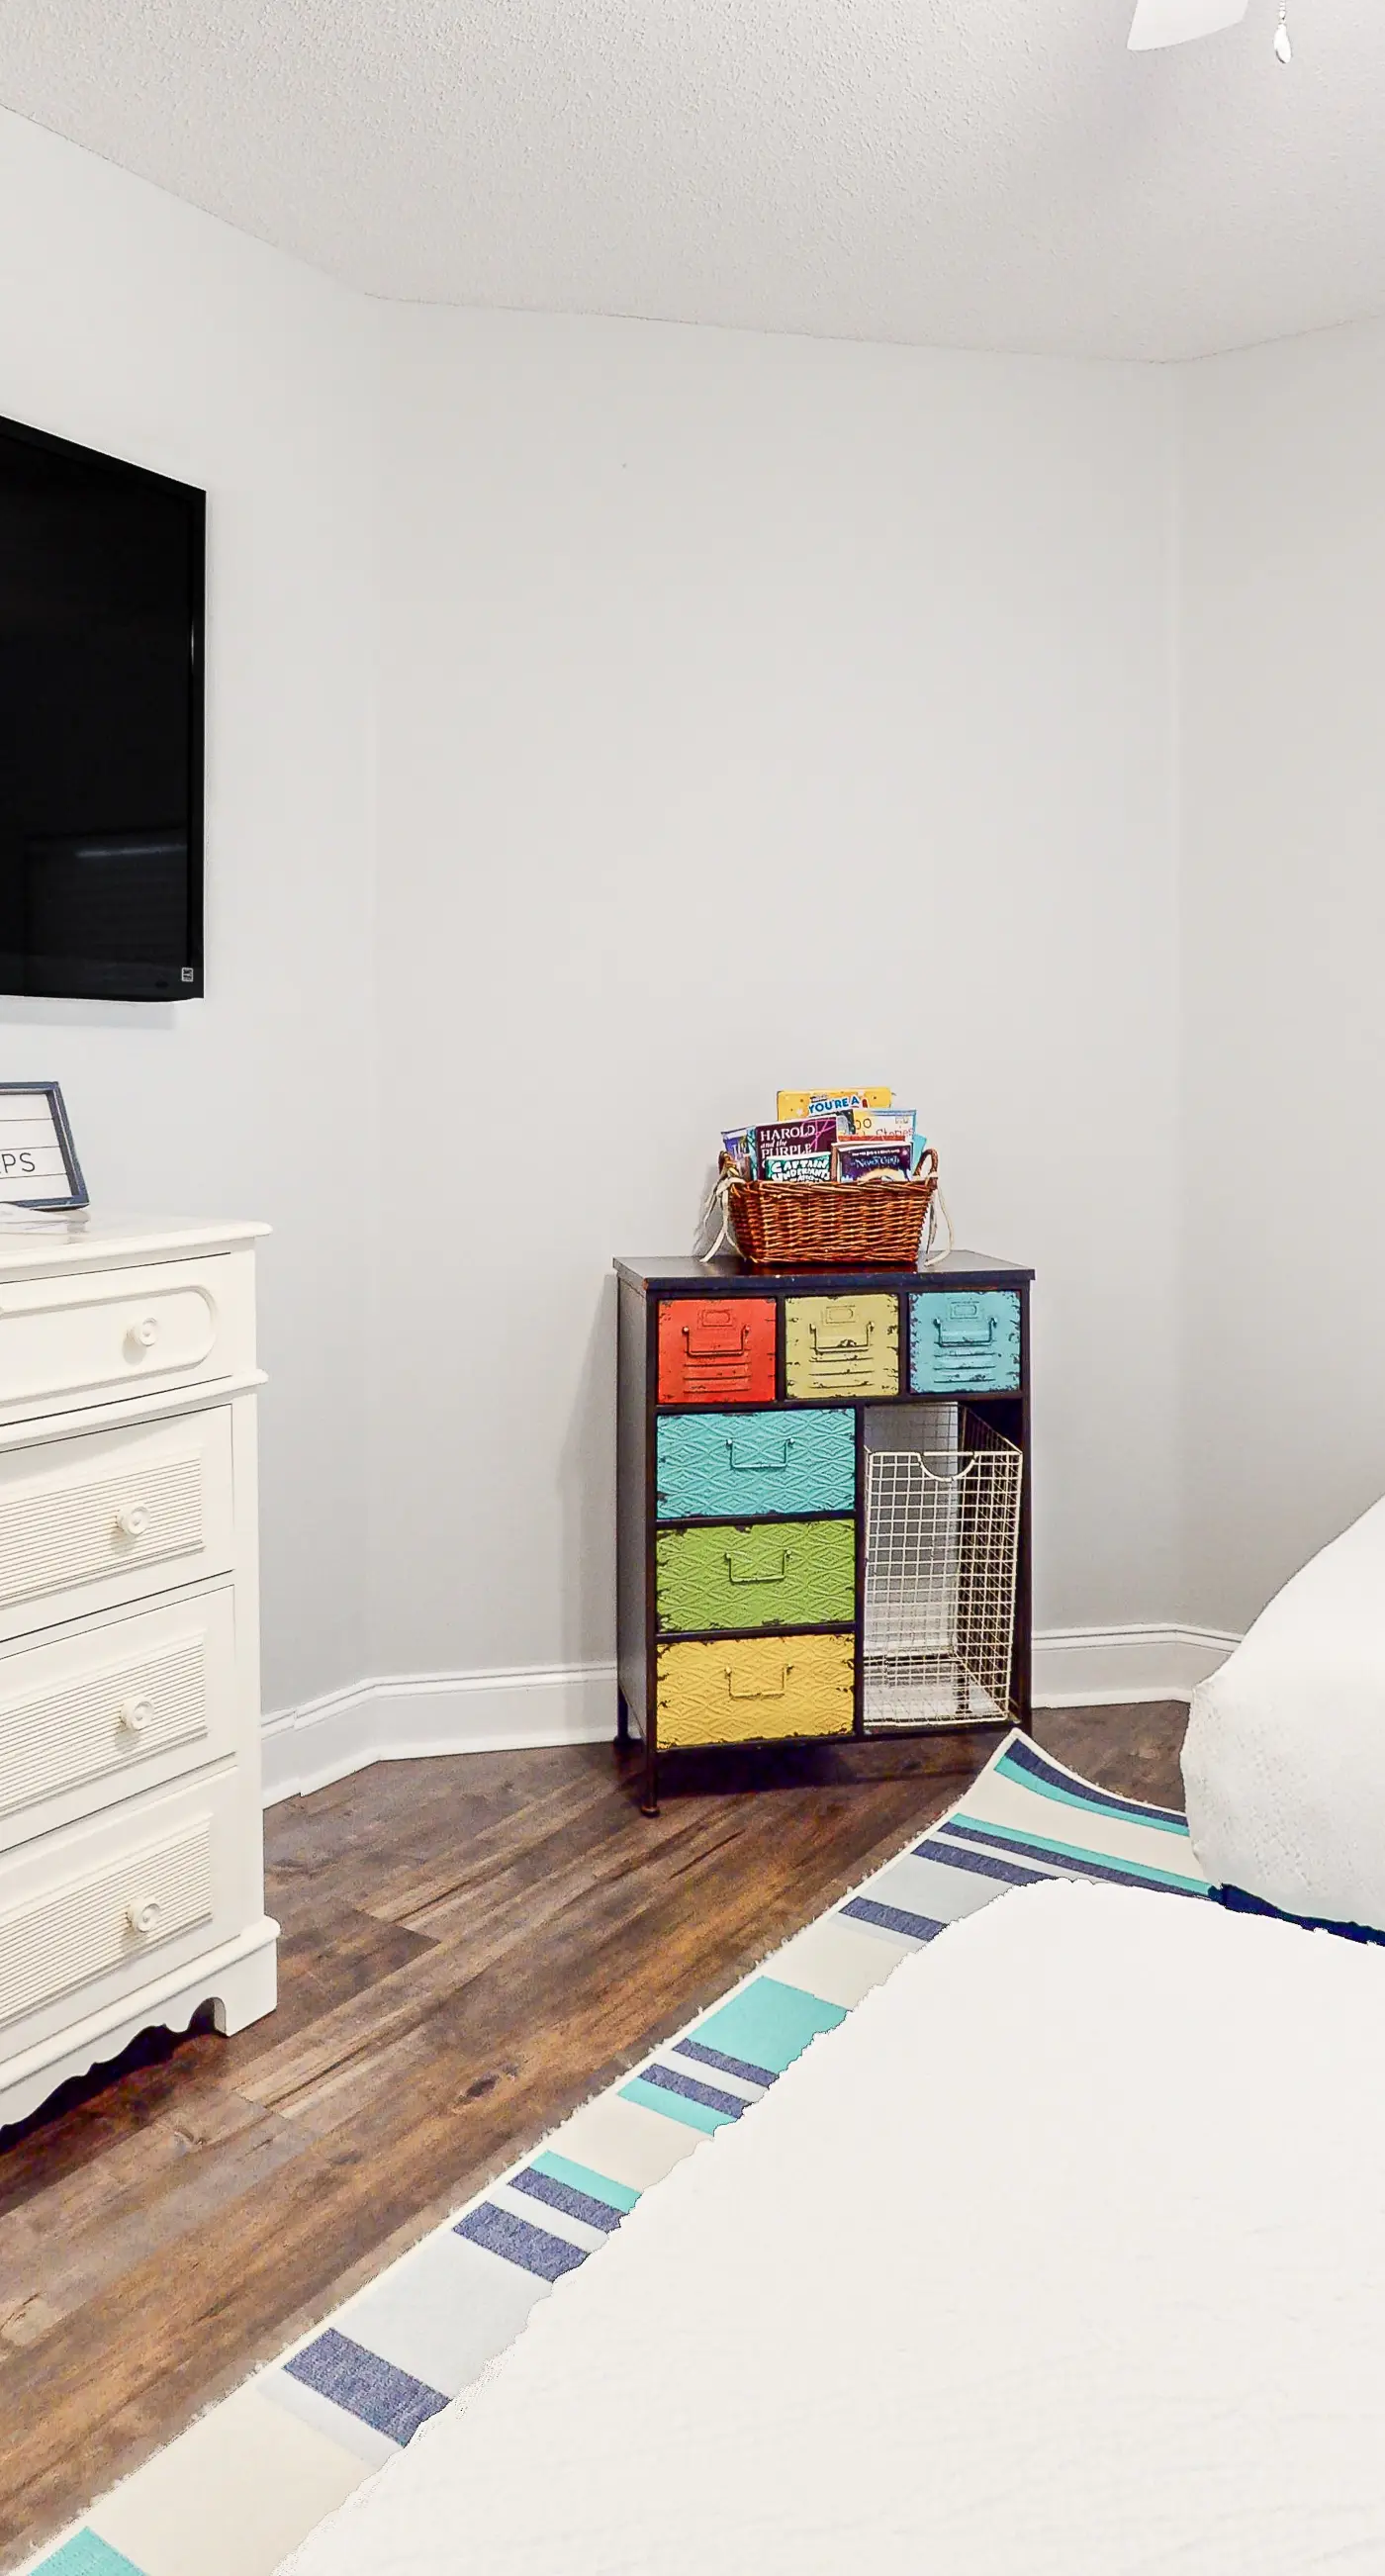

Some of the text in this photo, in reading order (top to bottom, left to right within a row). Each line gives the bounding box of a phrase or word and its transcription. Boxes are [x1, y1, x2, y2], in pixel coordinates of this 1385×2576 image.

[760, 1125, 816, 1142] HAROLD
[760, 1139, 787, 1149] and the
[761, 1143, 812, 1158] PURPLE
[0, 1152, 36, 1174] PS
[771, 1159, 829, 1173] CAPTAIN
